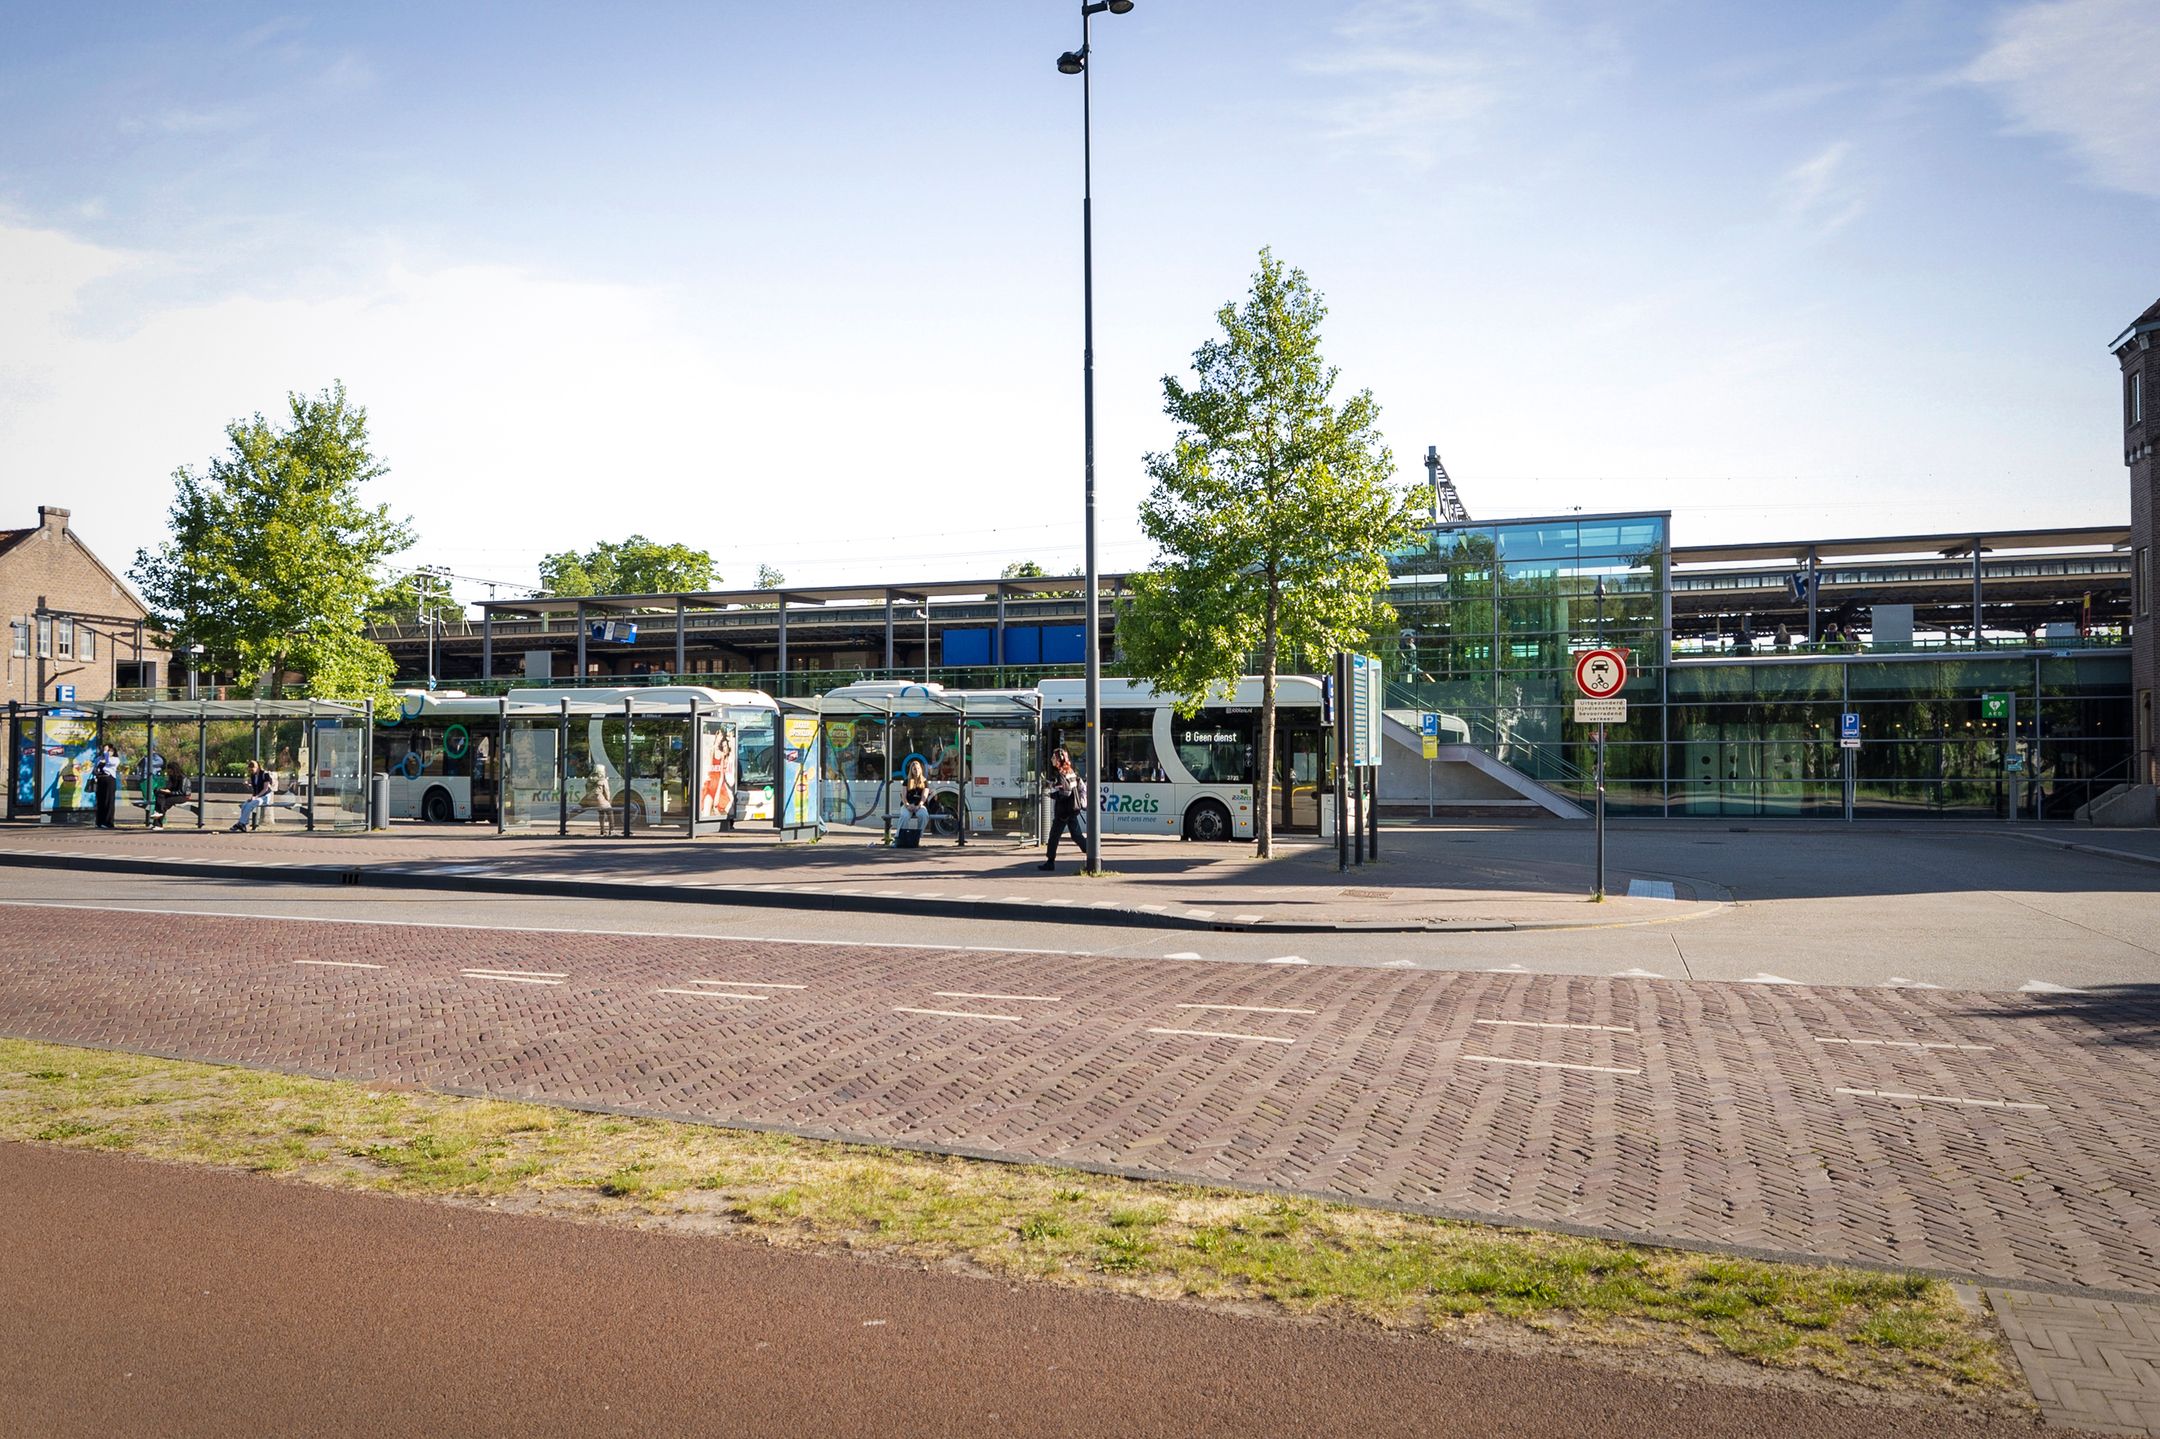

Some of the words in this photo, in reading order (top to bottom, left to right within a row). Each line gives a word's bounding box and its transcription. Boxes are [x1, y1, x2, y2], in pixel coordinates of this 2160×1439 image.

[61, 686, 73, 701] E
[1426, 716, 1434, 728] P
[1846, 716, 1855, 728] P
[1185, 731, 1192, 742] 8
[1193, 731, 1212, 742] Geen
[1213, 732, 1237, 742] dienst
